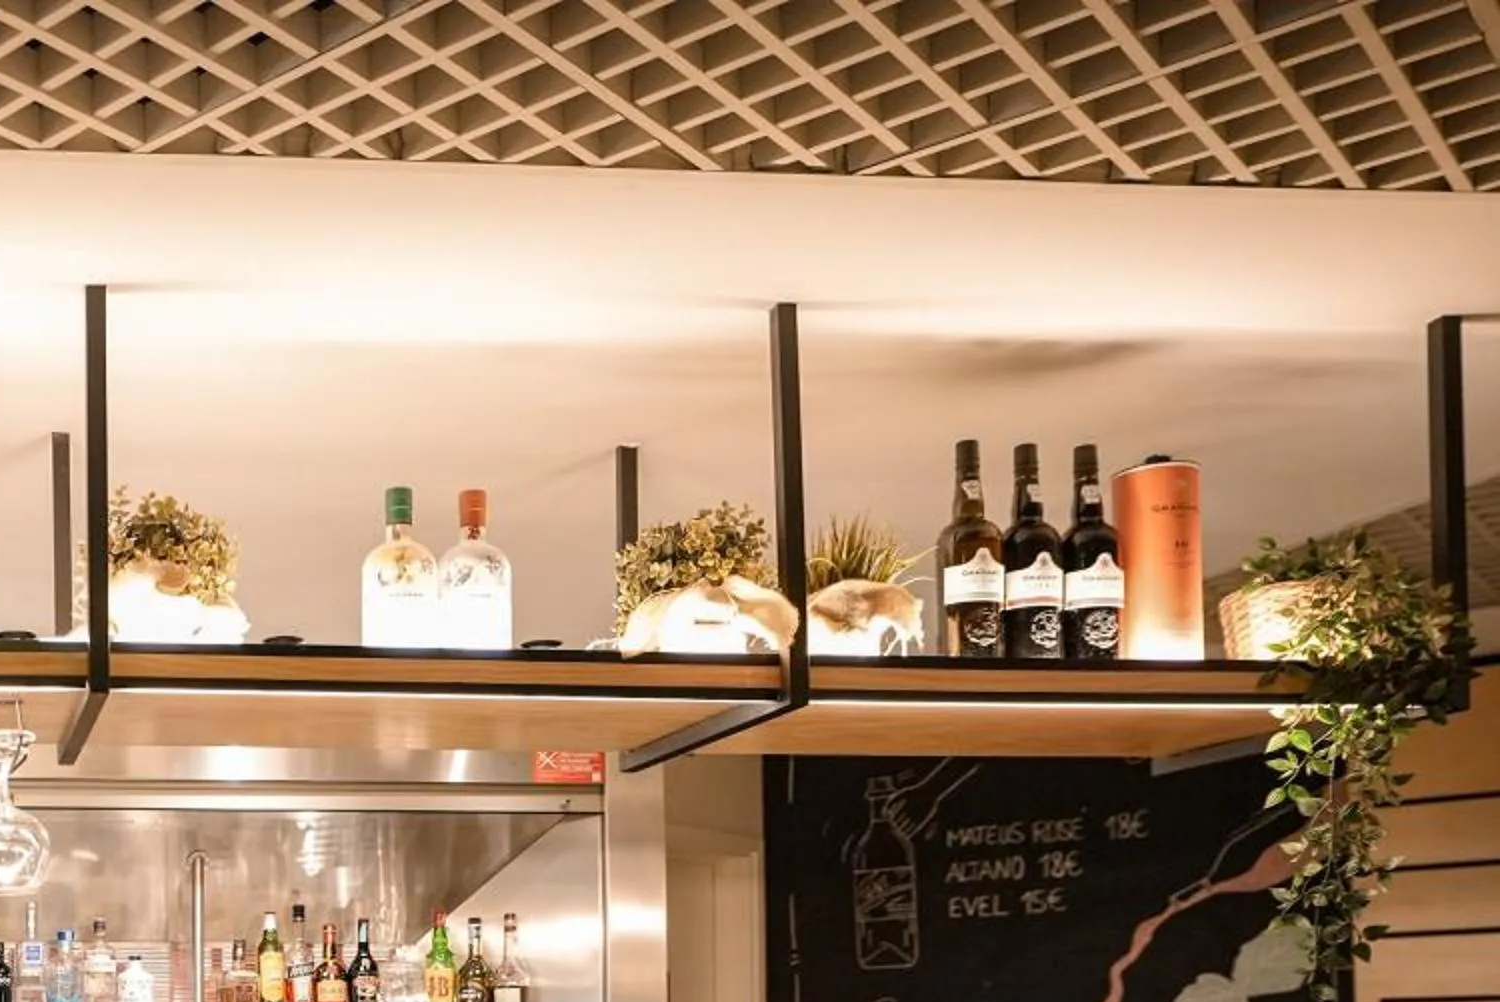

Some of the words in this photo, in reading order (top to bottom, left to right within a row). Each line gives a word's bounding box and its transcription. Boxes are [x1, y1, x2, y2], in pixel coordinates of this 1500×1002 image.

[945, 821, 1027, 848] MATEUS
[1105, 808, 1151, 841] 18€
[945, 854, 1027, 884] ALTANO
[1038, 850, 1084, 879] 18€
[948, 895, 1012, 919] EVEL
[1020, 887, 1069, 915] 15€
